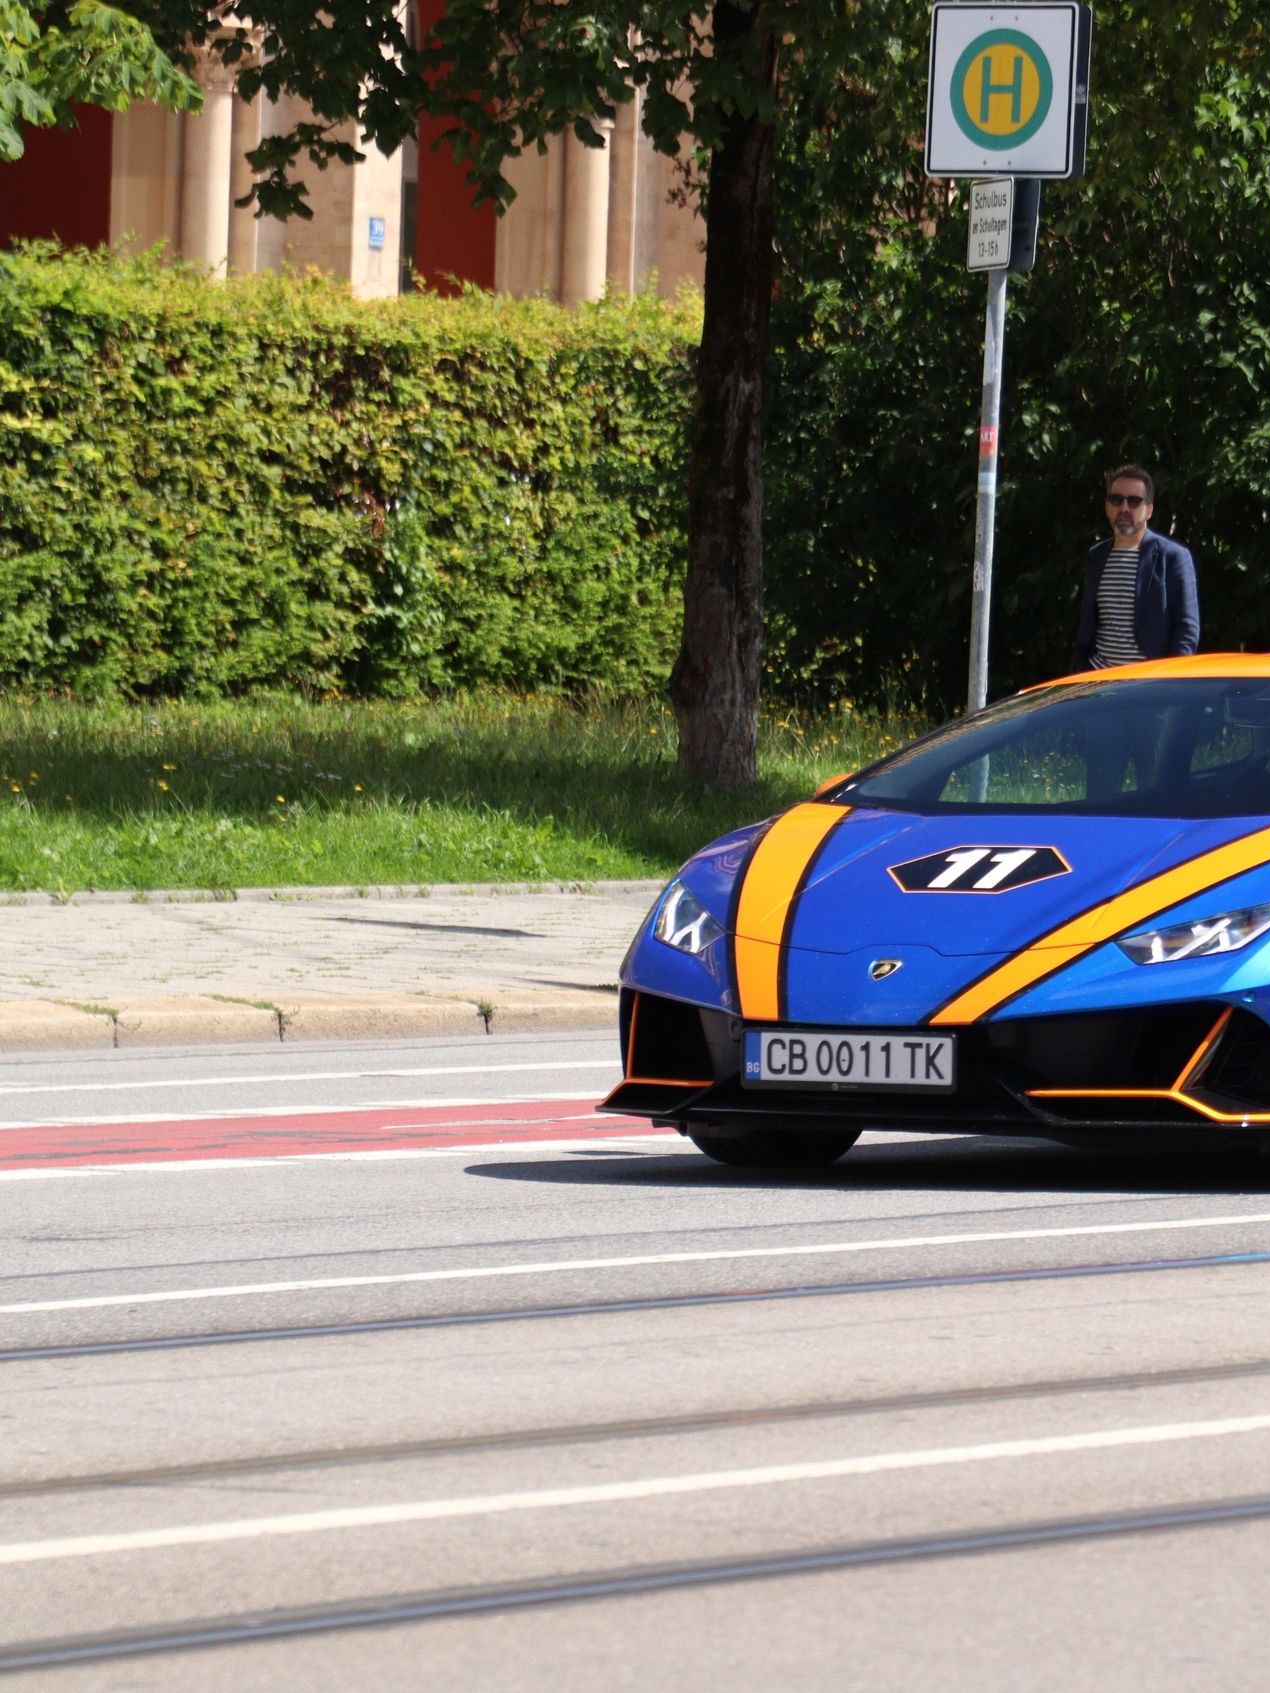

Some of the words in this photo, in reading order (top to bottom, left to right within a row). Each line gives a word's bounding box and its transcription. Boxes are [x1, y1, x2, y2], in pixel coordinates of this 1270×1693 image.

[979, 55, 1024, 124] H
[975, 191, 1007, 210] Schulbus
[972, 222, 979, 235] an
[979, 217, 1008, 236] Schultagen
[927, 848, 1037, 889] 11
[746, 1061, 760, 1073] BG
